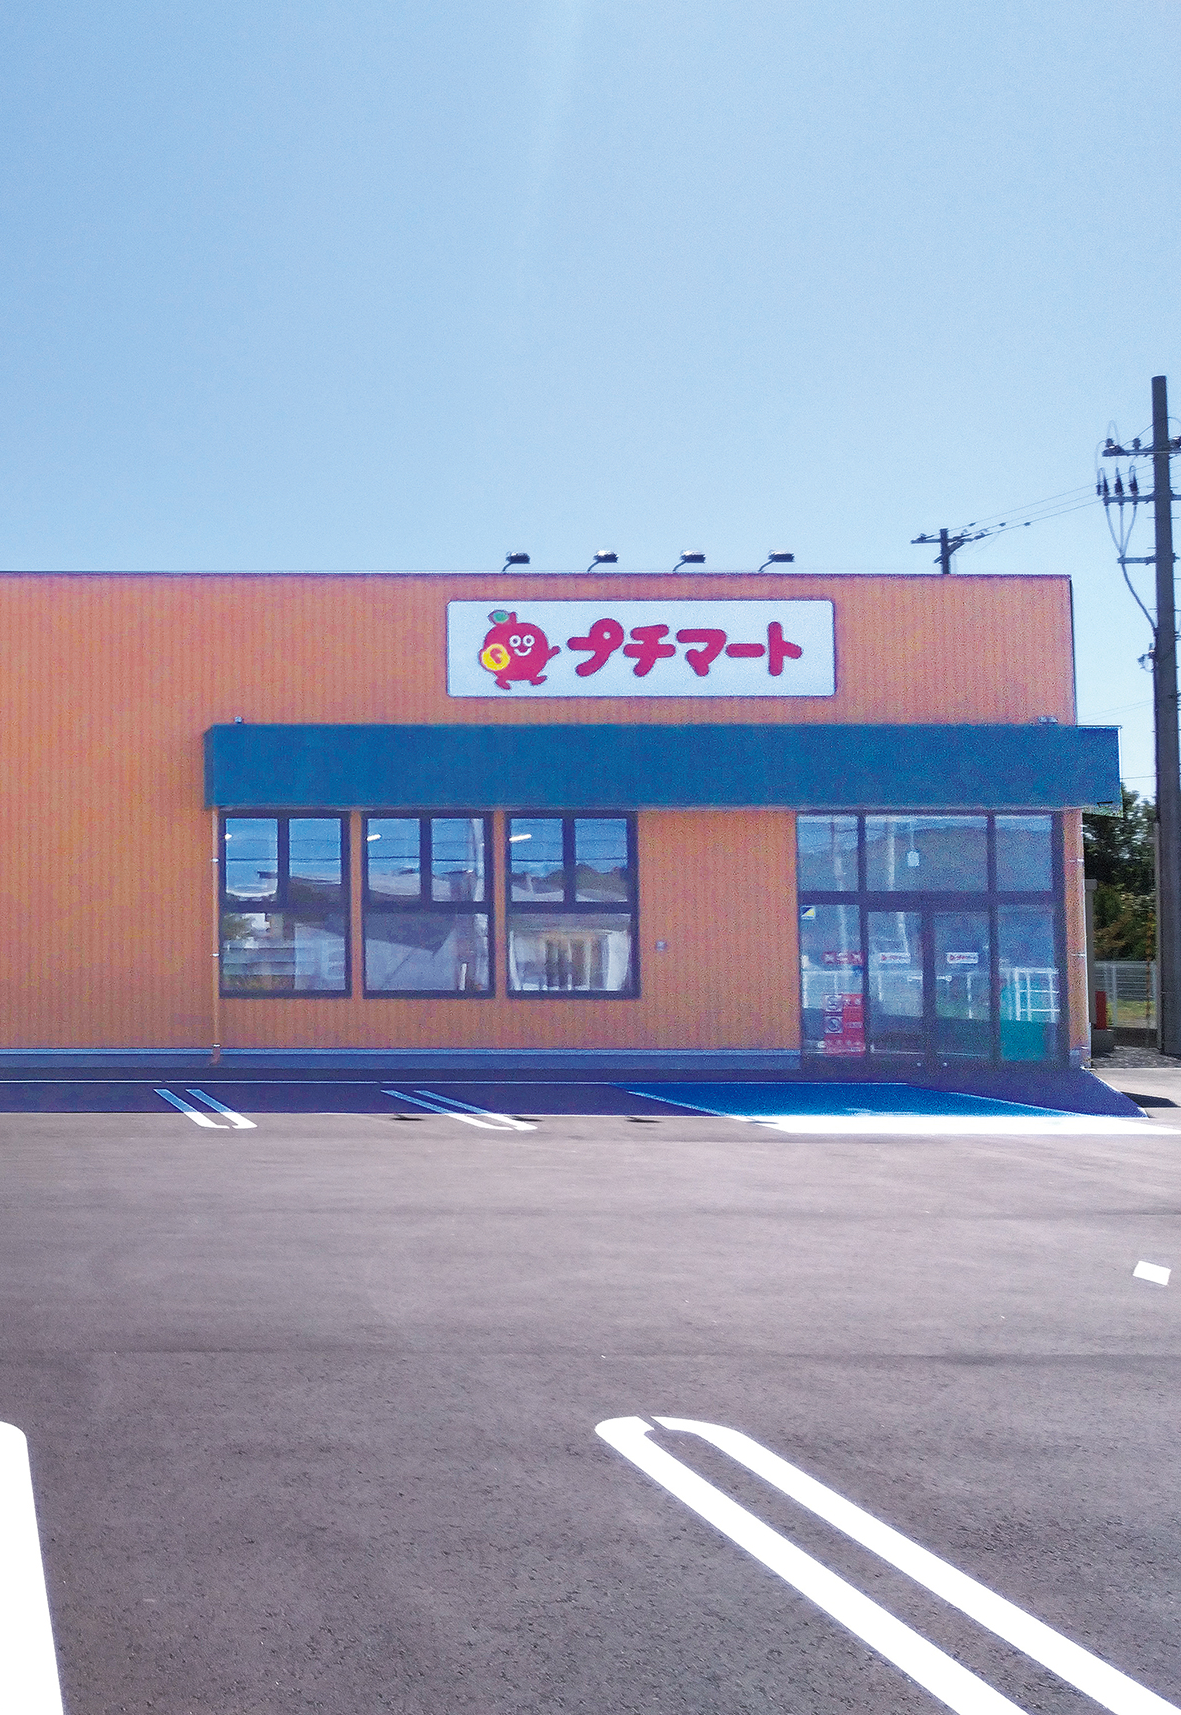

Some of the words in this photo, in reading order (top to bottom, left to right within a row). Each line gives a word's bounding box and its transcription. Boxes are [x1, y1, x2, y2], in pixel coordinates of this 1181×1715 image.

[567, 618, 803, 677] プチマート
